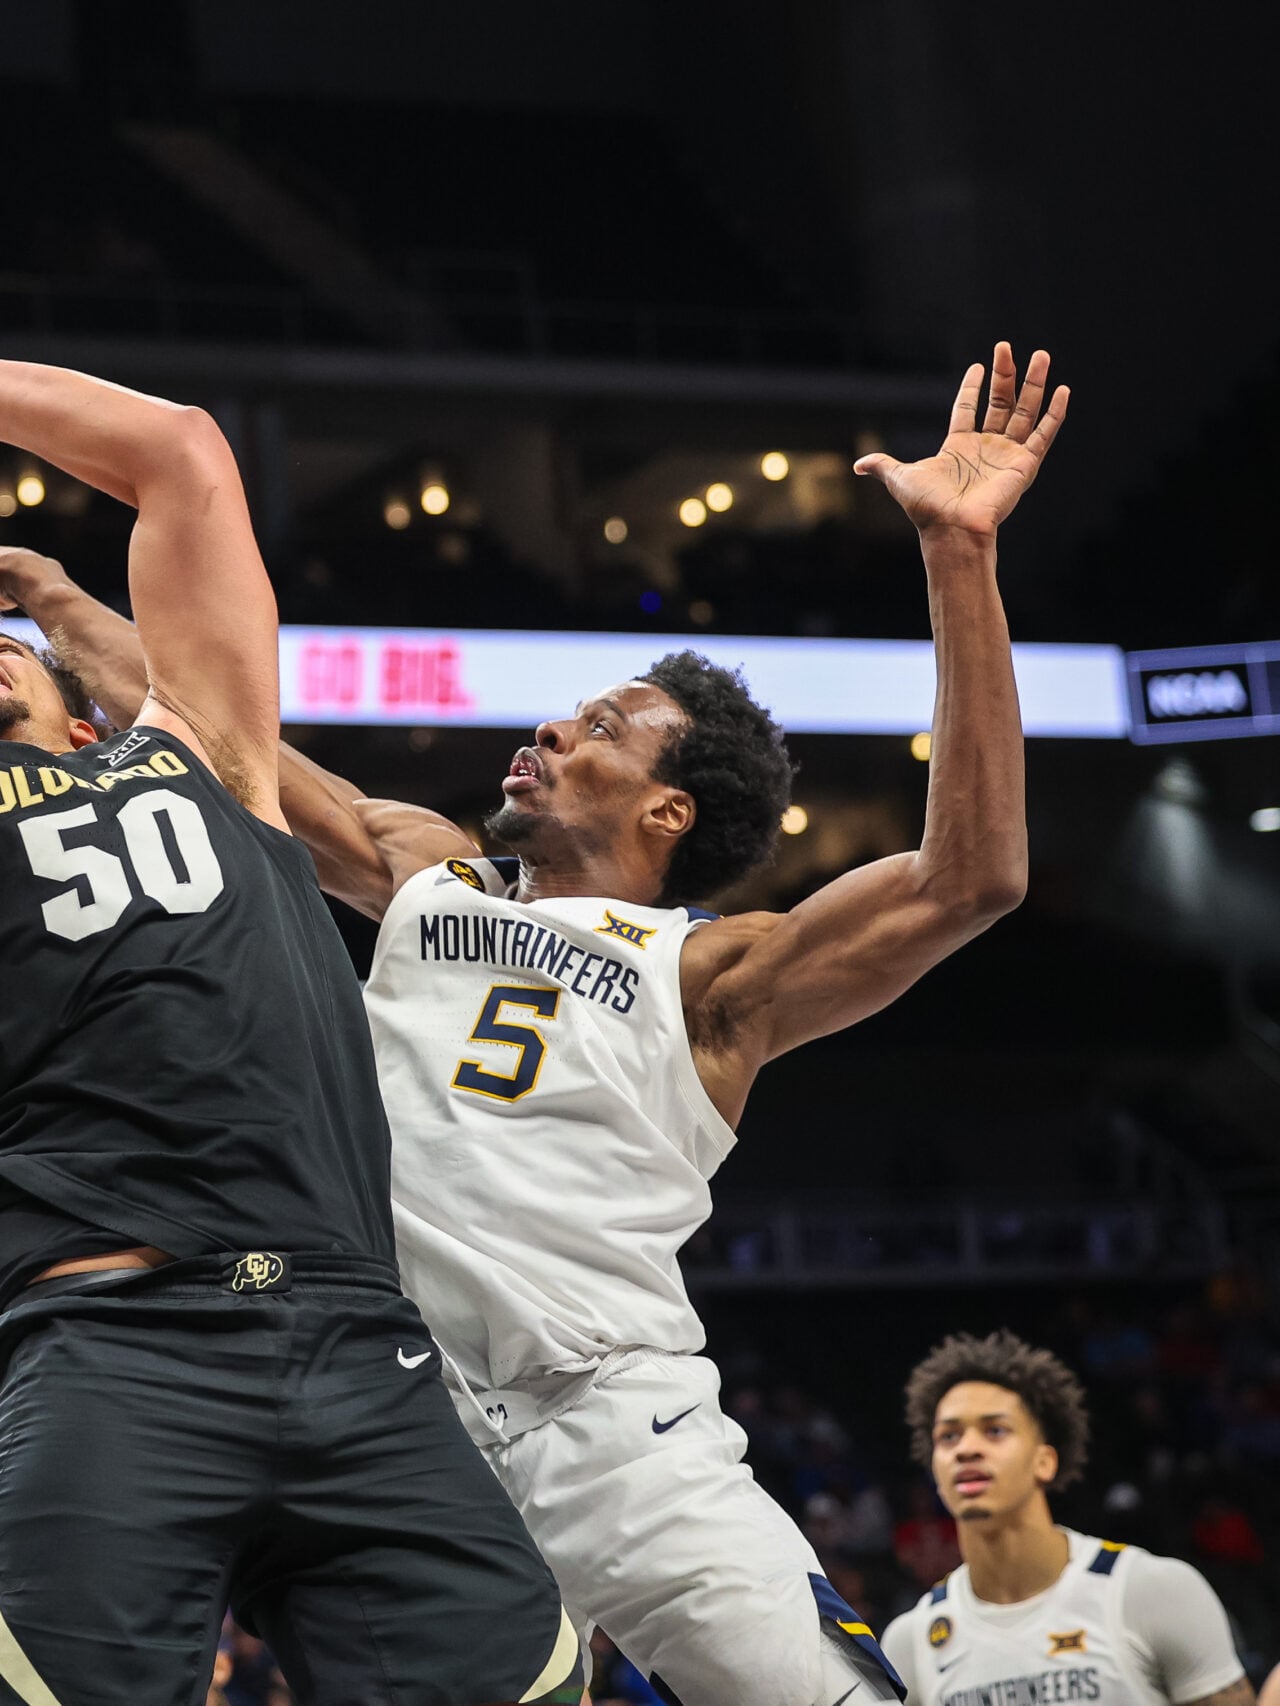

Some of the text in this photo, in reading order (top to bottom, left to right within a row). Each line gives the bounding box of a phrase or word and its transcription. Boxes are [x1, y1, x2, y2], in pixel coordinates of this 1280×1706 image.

[17, 788, 225, 942] 50
[420, 914, 640, 1014] MOUNTAINEERS
[450, 984, 561, 1103] 5
[246, 1253, 271, 1280] CU
